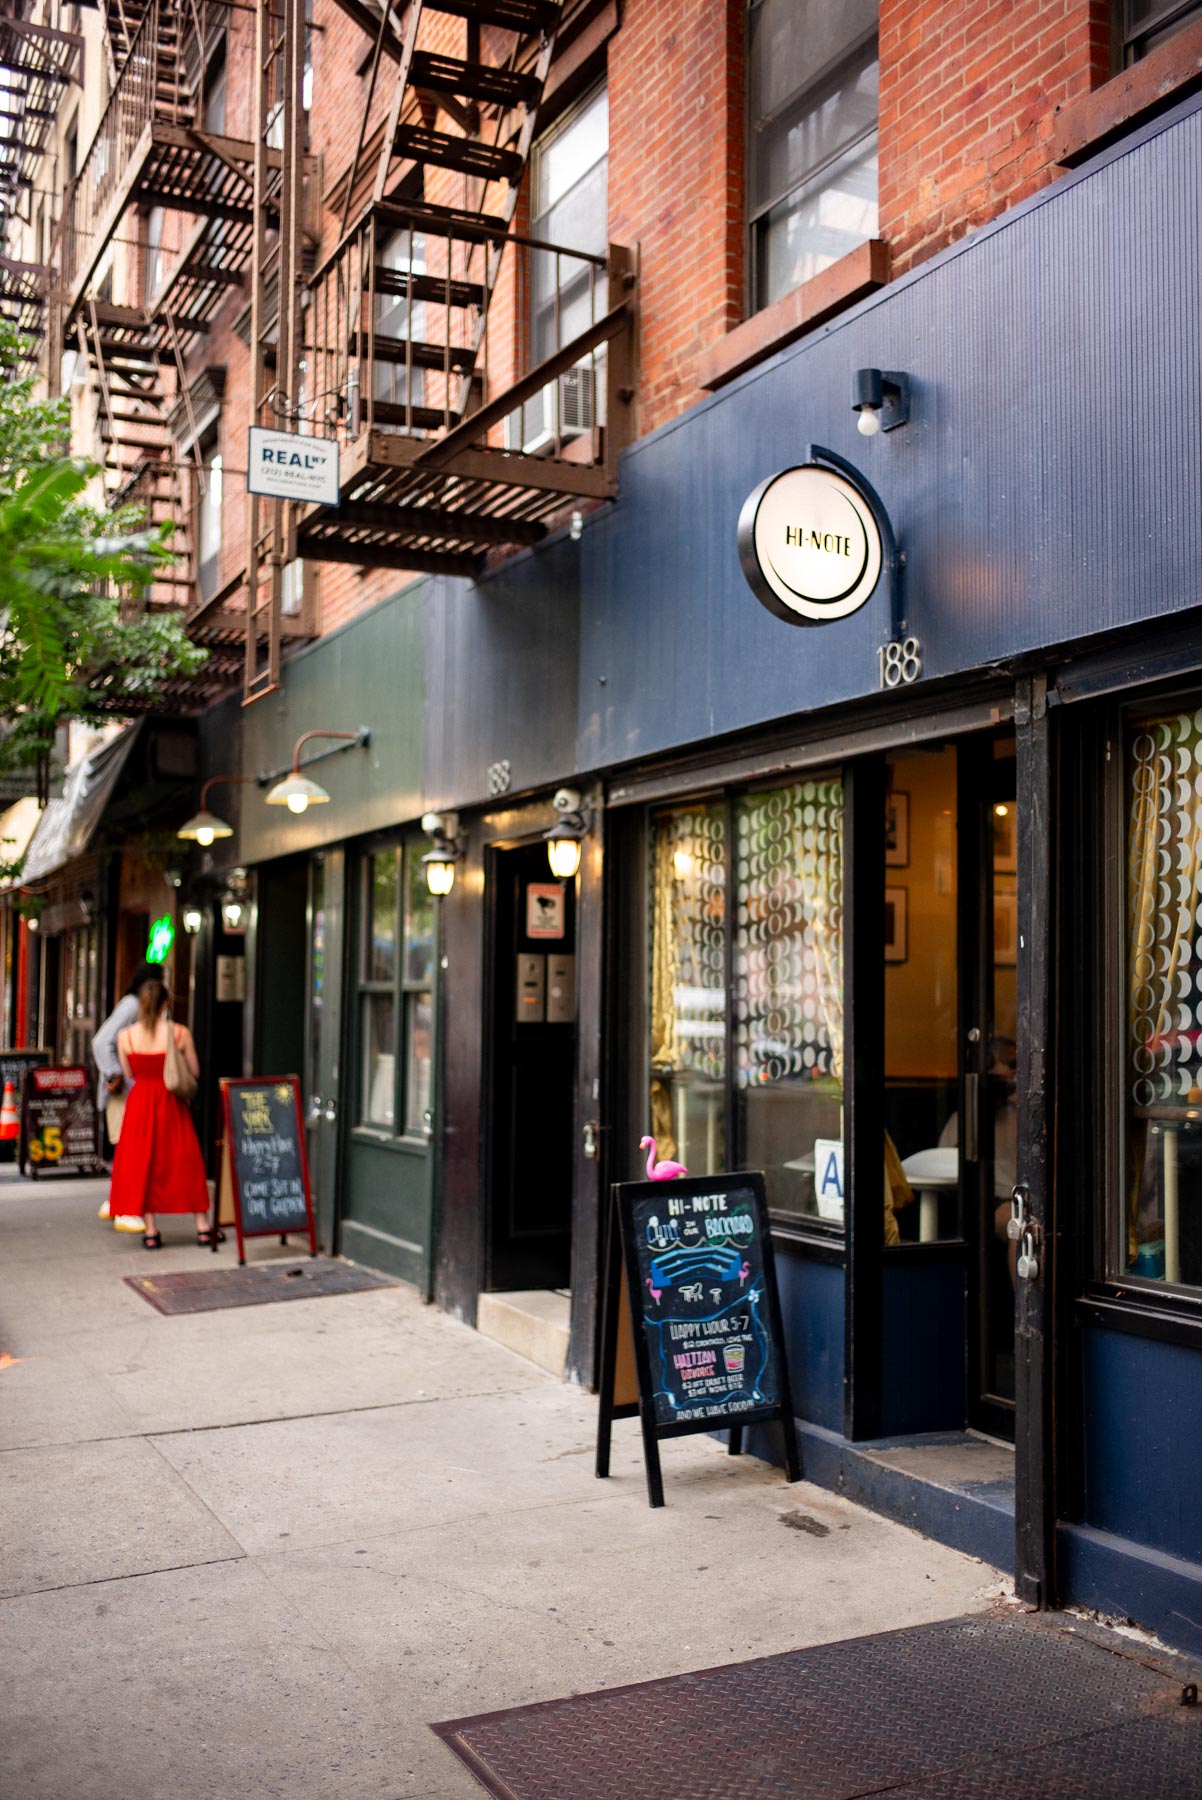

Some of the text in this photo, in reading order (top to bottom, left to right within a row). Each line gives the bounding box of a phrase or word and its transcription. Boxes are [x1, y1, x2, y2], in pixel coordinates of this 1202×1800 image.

[786, 525, 851, 557] HI-NOTE
[876, 637, 921, 689] 188
[821, 1151, 844, 1197] A
[668, 1194, 728, 1216] HI-NOTE
[704, 1214, 754, 1238] BACKYARD
[669, 1315, 750, 1341] HAPPY HOUR 5-7
[673, 1350, 717, 1370] HAITIAN
[676, 1408, 693, 1421] AND
[692, 1405, 705, 1418] WE
[705, 1402, 729, 1415] HAVE
